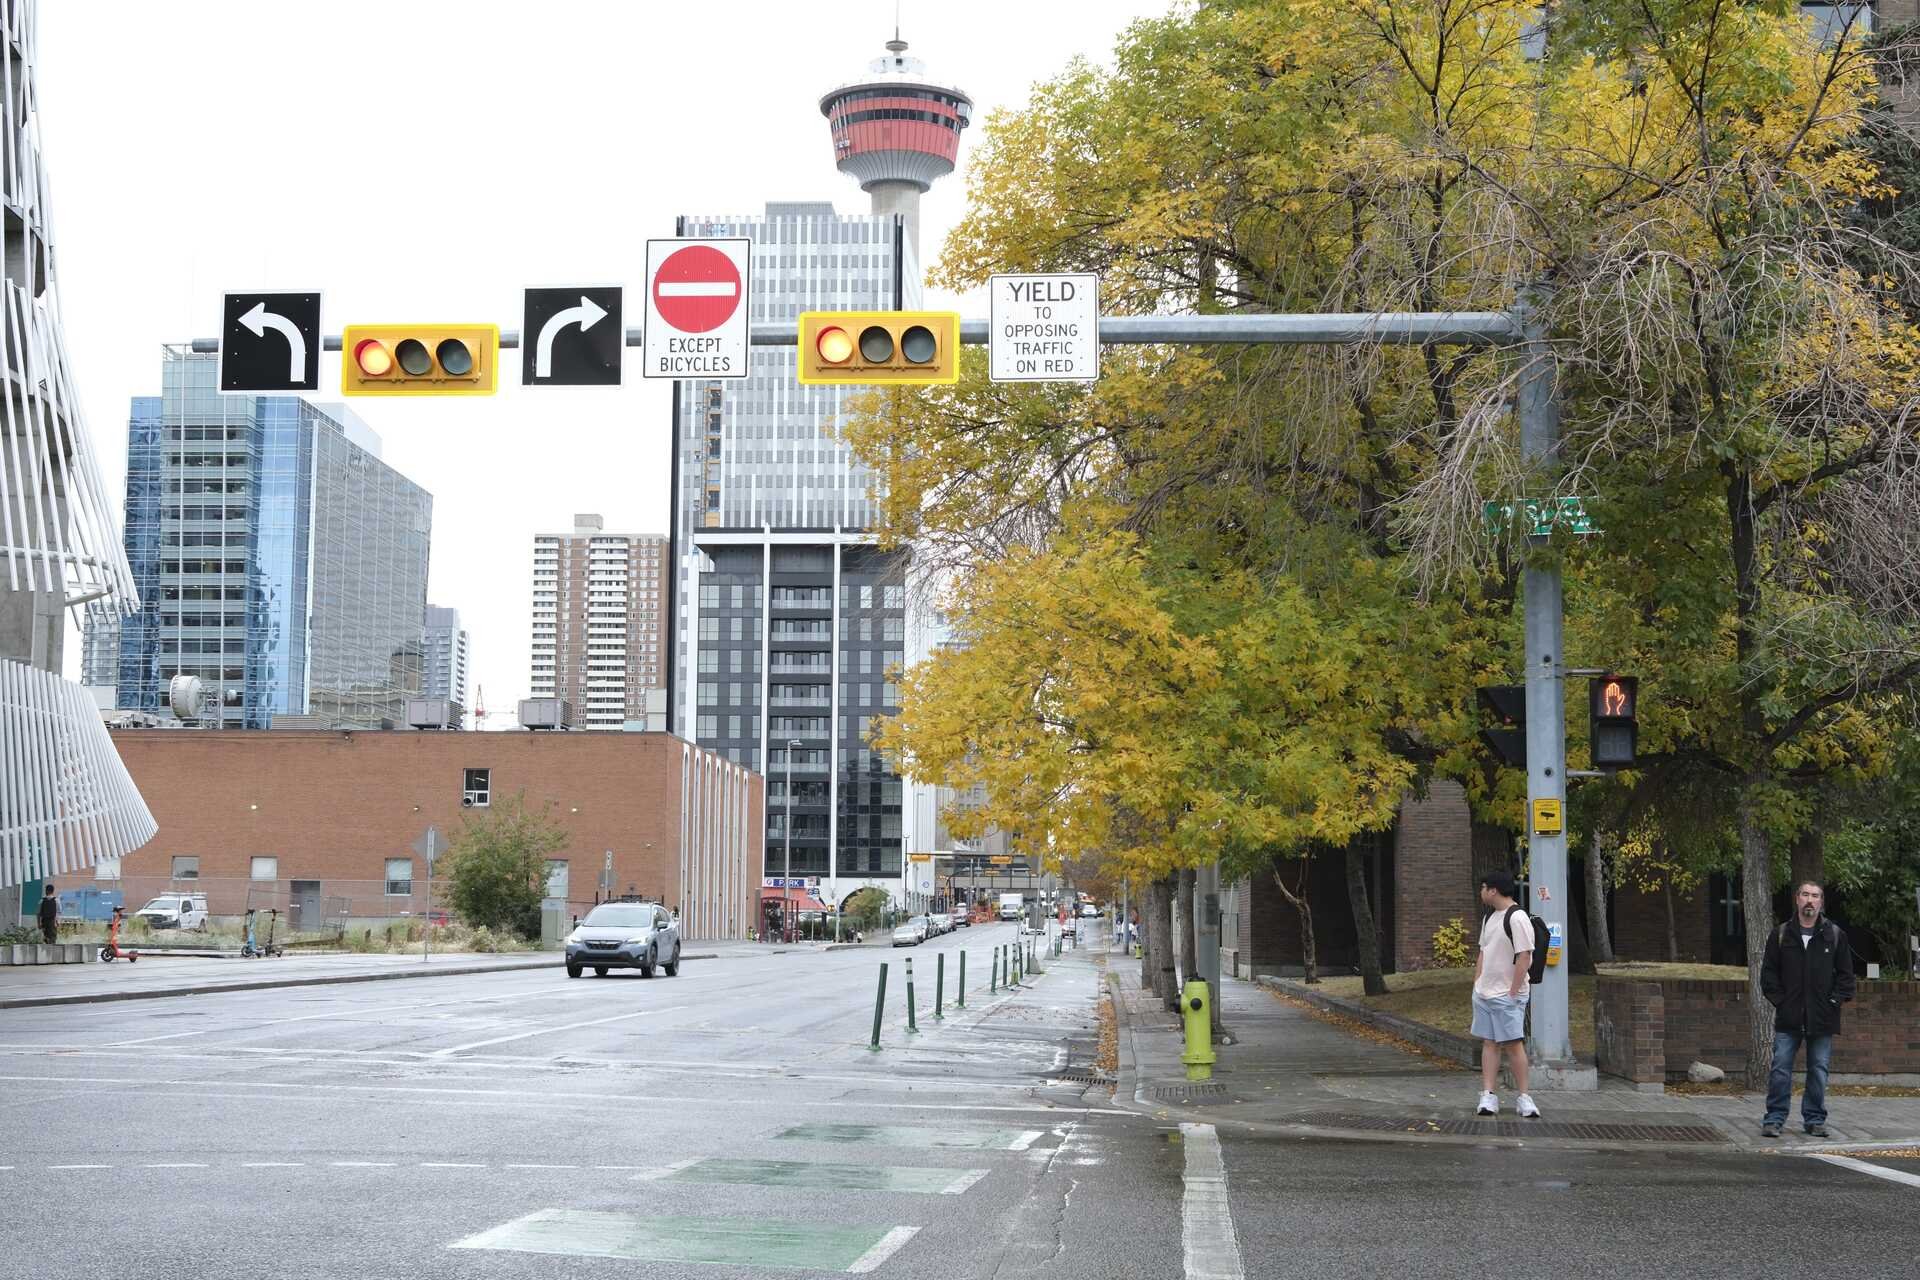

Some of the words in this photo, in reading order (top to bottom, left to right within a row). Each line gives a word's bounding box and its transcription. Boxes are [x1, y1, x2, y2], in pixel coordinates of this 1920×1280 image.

[1008, 281, 1075, 302] YIELD
[1033, 306, 1052, 319] TO
[1005, 324, 1078, 337] OPPOSING
[669, 337, 722, 353] EXCEPT
[1013, 341, 1073, 355] TRAFFIC
[660, 356, 730, 372] BICYCLES
[1016, 360, 1036, 373] ON
[1044, 359, 1074, 373] RED
[778, 879, 800, 887] PRK
